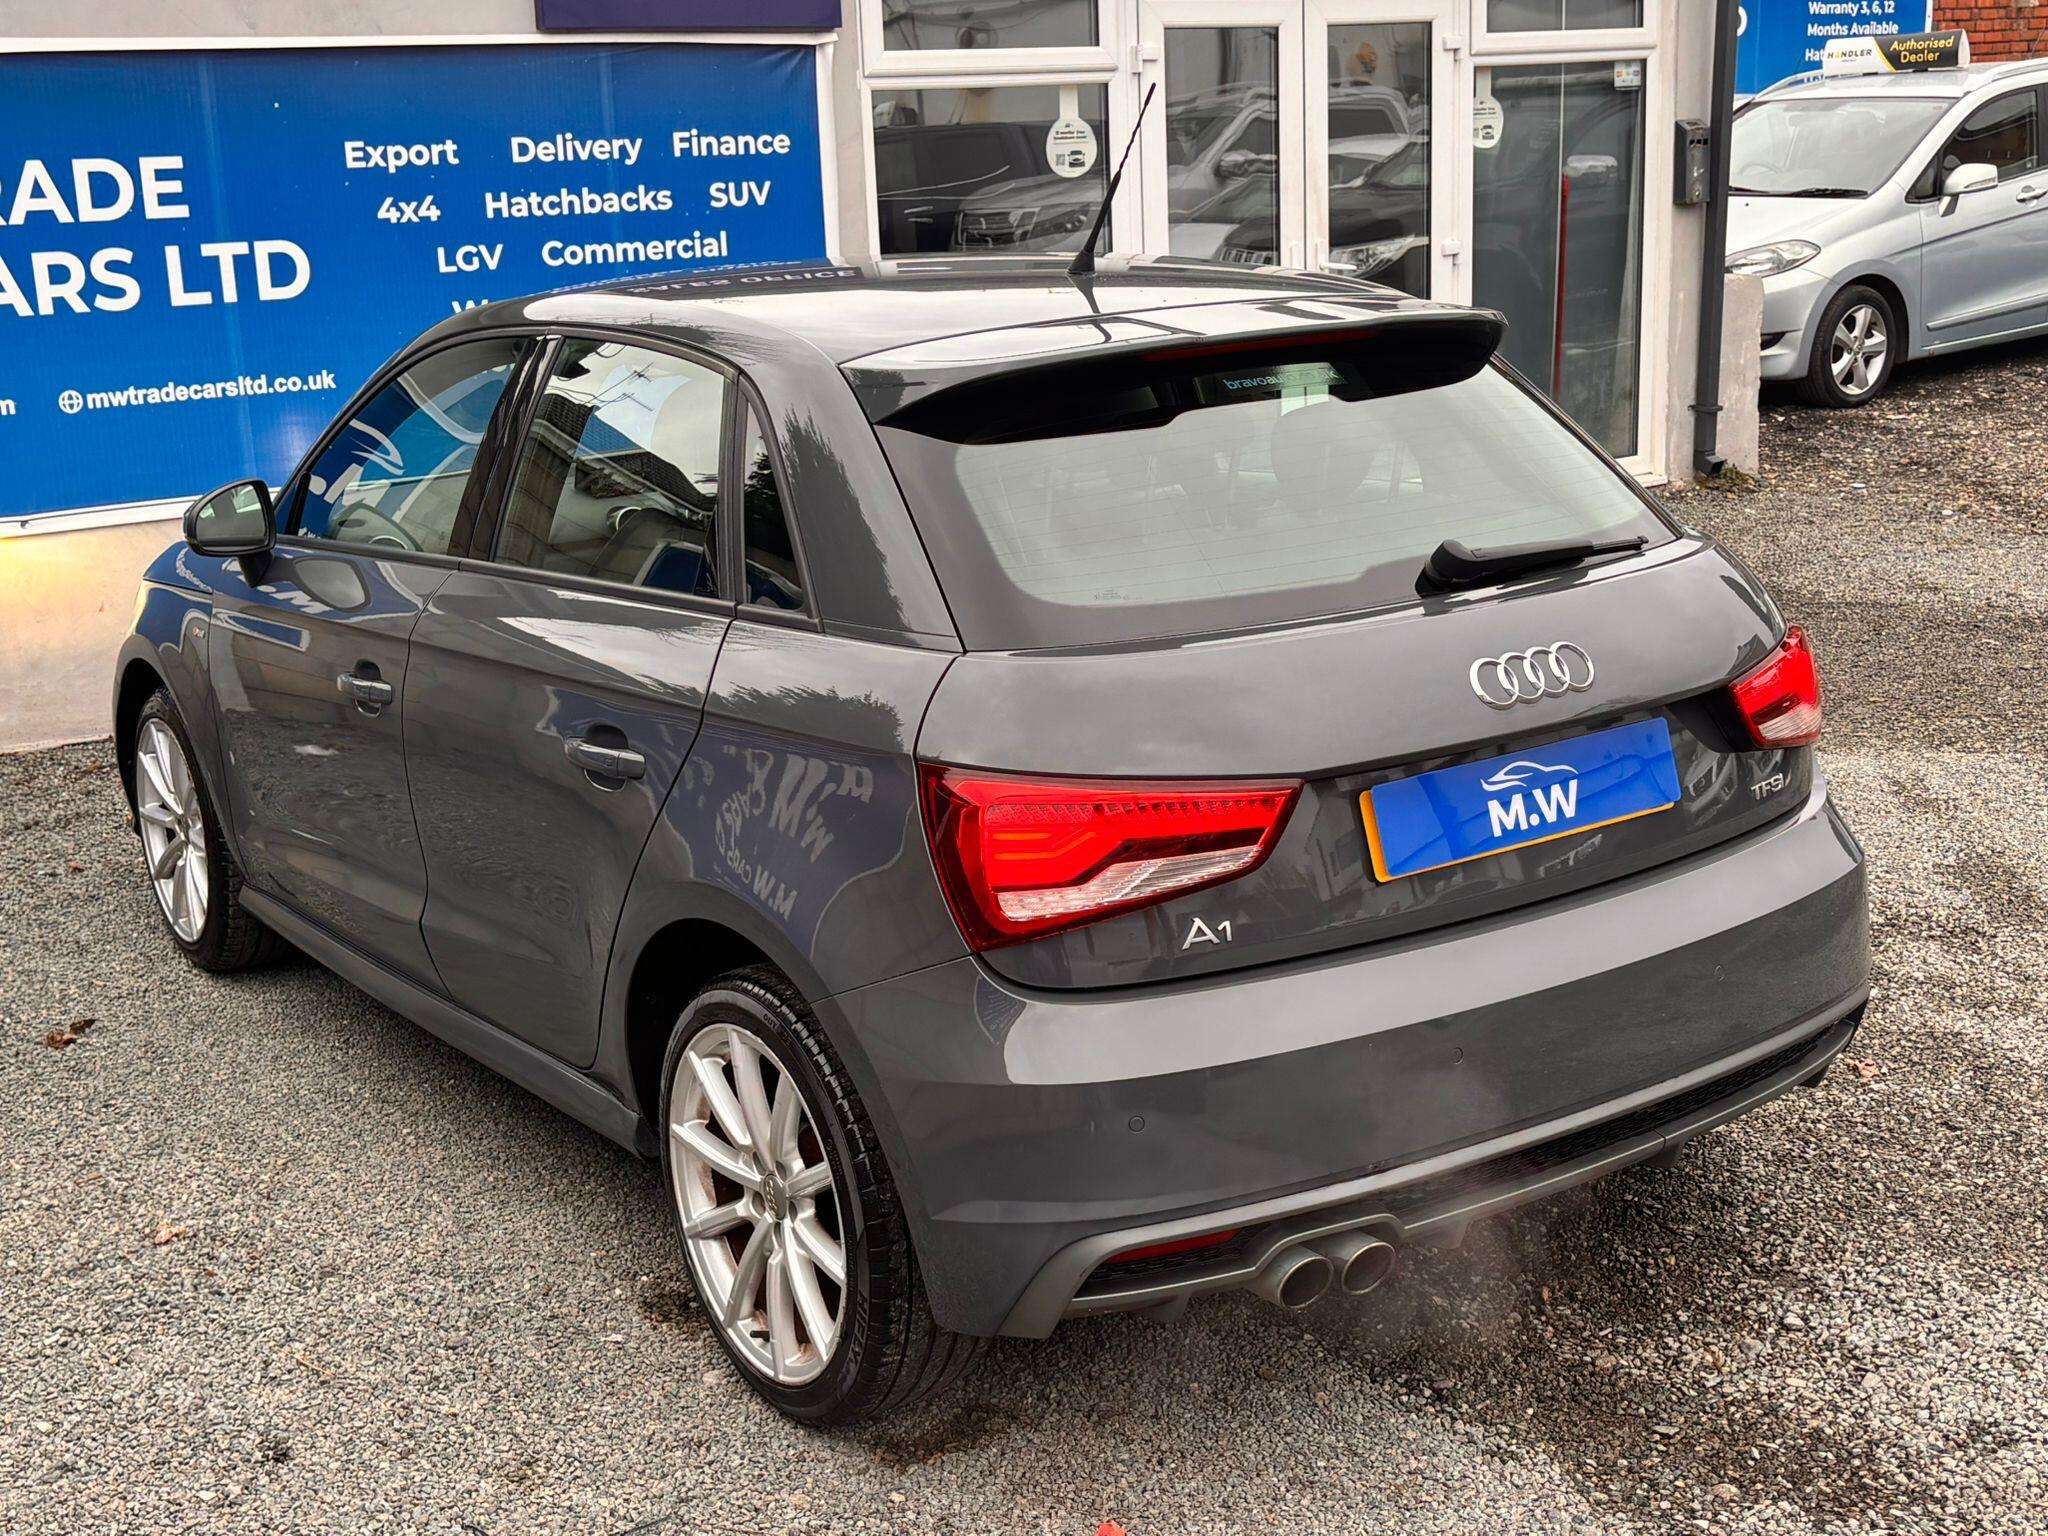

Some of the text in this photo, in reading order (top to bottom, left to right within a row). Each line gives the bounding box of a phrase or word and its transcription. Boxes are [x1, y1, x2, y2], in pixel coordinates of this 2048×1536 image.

[1808, 1, 1859, 17] Warranty
[1884, 1, 1895, 13] 12
[1807, 21, 1899, 36] Months Available
[1889, 36, 1955, 52] Authorised
[1827, 49, 1873, 59] HANDLER
[1900, 51, 1940, 63] Dealer
[345, 129, 790, 173] Export Delivery Finance
[0, 156, 189, 226] ADE
[378, 181, 771, 223] 4x4 Hatchbacks SUV
[438, 231, 728, 273] LGV Commercial
[164, 240, 311, 307] LTD
[86, 370, 336, 410] mwtradecarsltd.co.uk
[1750, 772, 1785, 800] TFSI
[1488, 779, 1578, 838] M.W
[1182, 917, 1232, 950] A1
